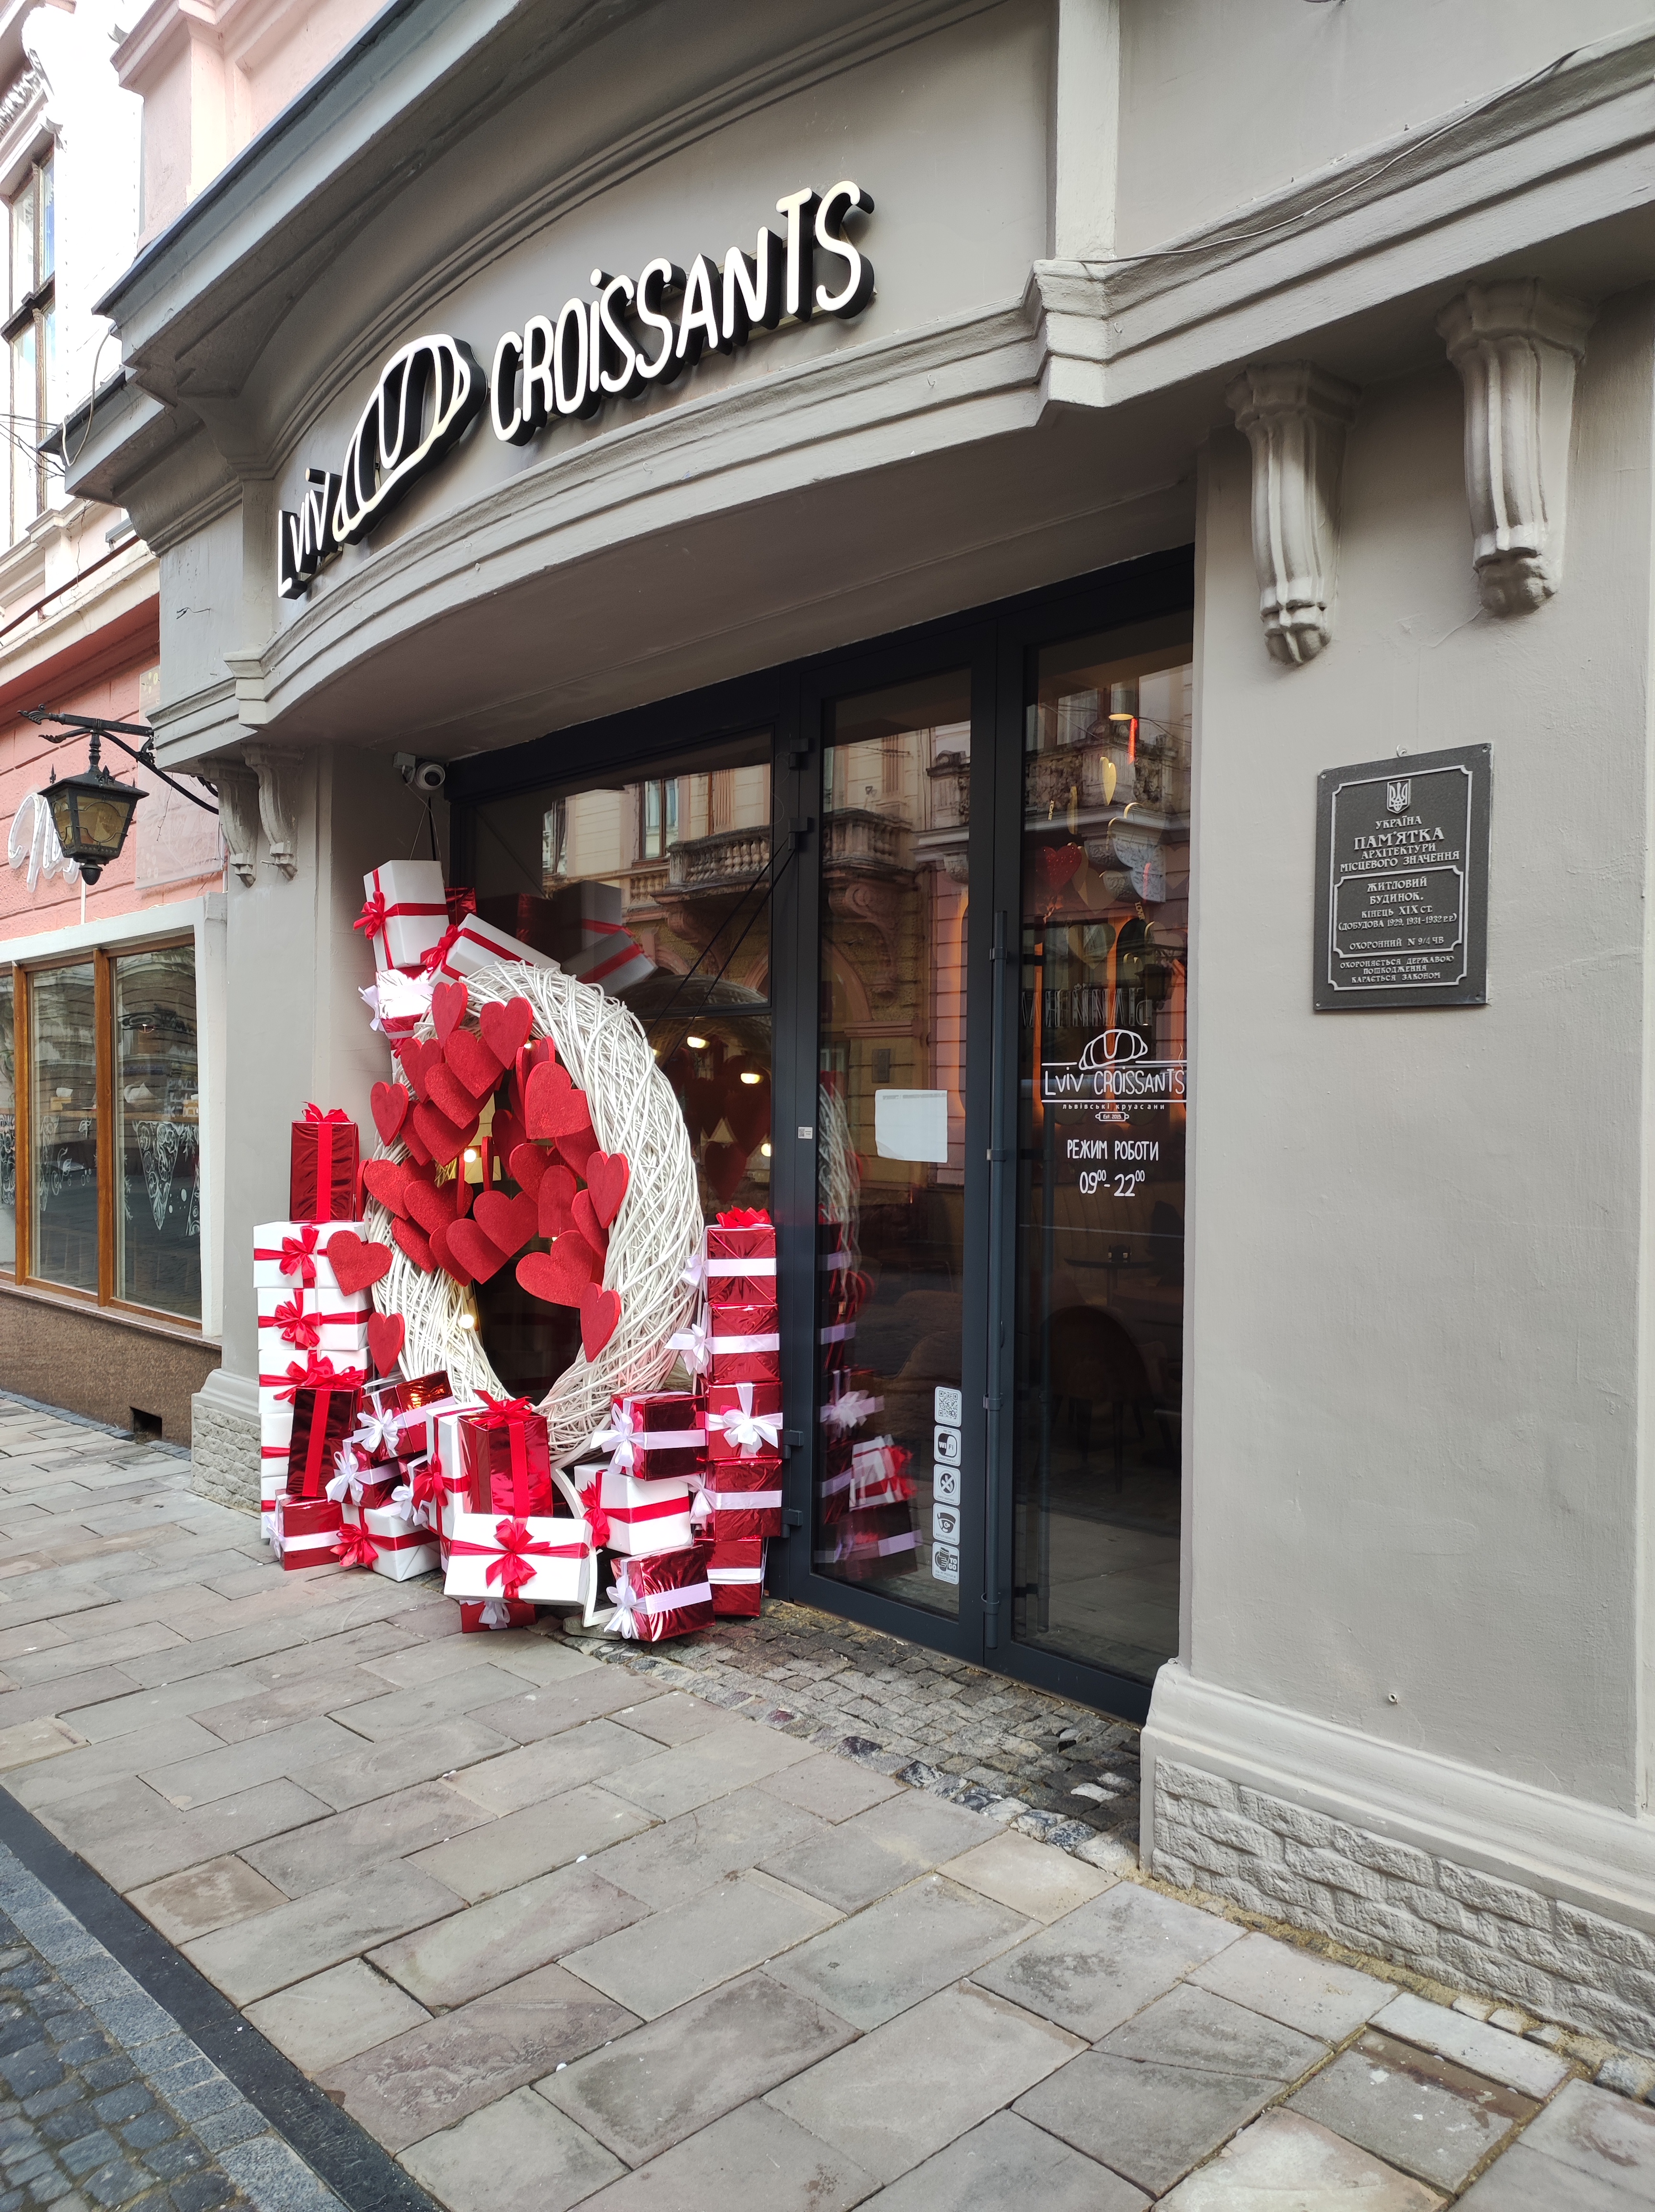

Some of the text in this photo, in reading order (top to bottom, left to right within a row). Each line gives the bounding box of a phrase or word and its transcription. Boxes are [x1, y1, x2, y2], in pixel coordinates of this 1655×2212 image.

[1375, 815, 1422, 830] УКРАЇНА
[1361, 843, 1436, 860] АРХІТЕКТУРИ
[1340, 851, 1460, 872] МІСЦЕВОГО ЗНАЧЕННЯ
[1367, 876, 1427, 892] ЖИТЛОВИЙ
[1369, 892, 1424, 904] БУДИНОК.
[1361, 908, 1394, 918] КІНЕЦЬ
[1338, 921, 1384, 931] (ДОБУДОВА
[1349, 938, 1402, 950] ОХОРОННИЙ
[1340, 956, 1454, 969] ОХОРОНЯЄТЬСЯ ДЕРЖАВОЮ
[1363, 965, 1427, 975] ПОШКОДЖЕННЯ
[1351, 973, 1440, 983] КАРАЄТЬСЯ ЗАКОНОМ
[1067, 1139, 1159, 1161] РЕЖИМ РОБОТИ
